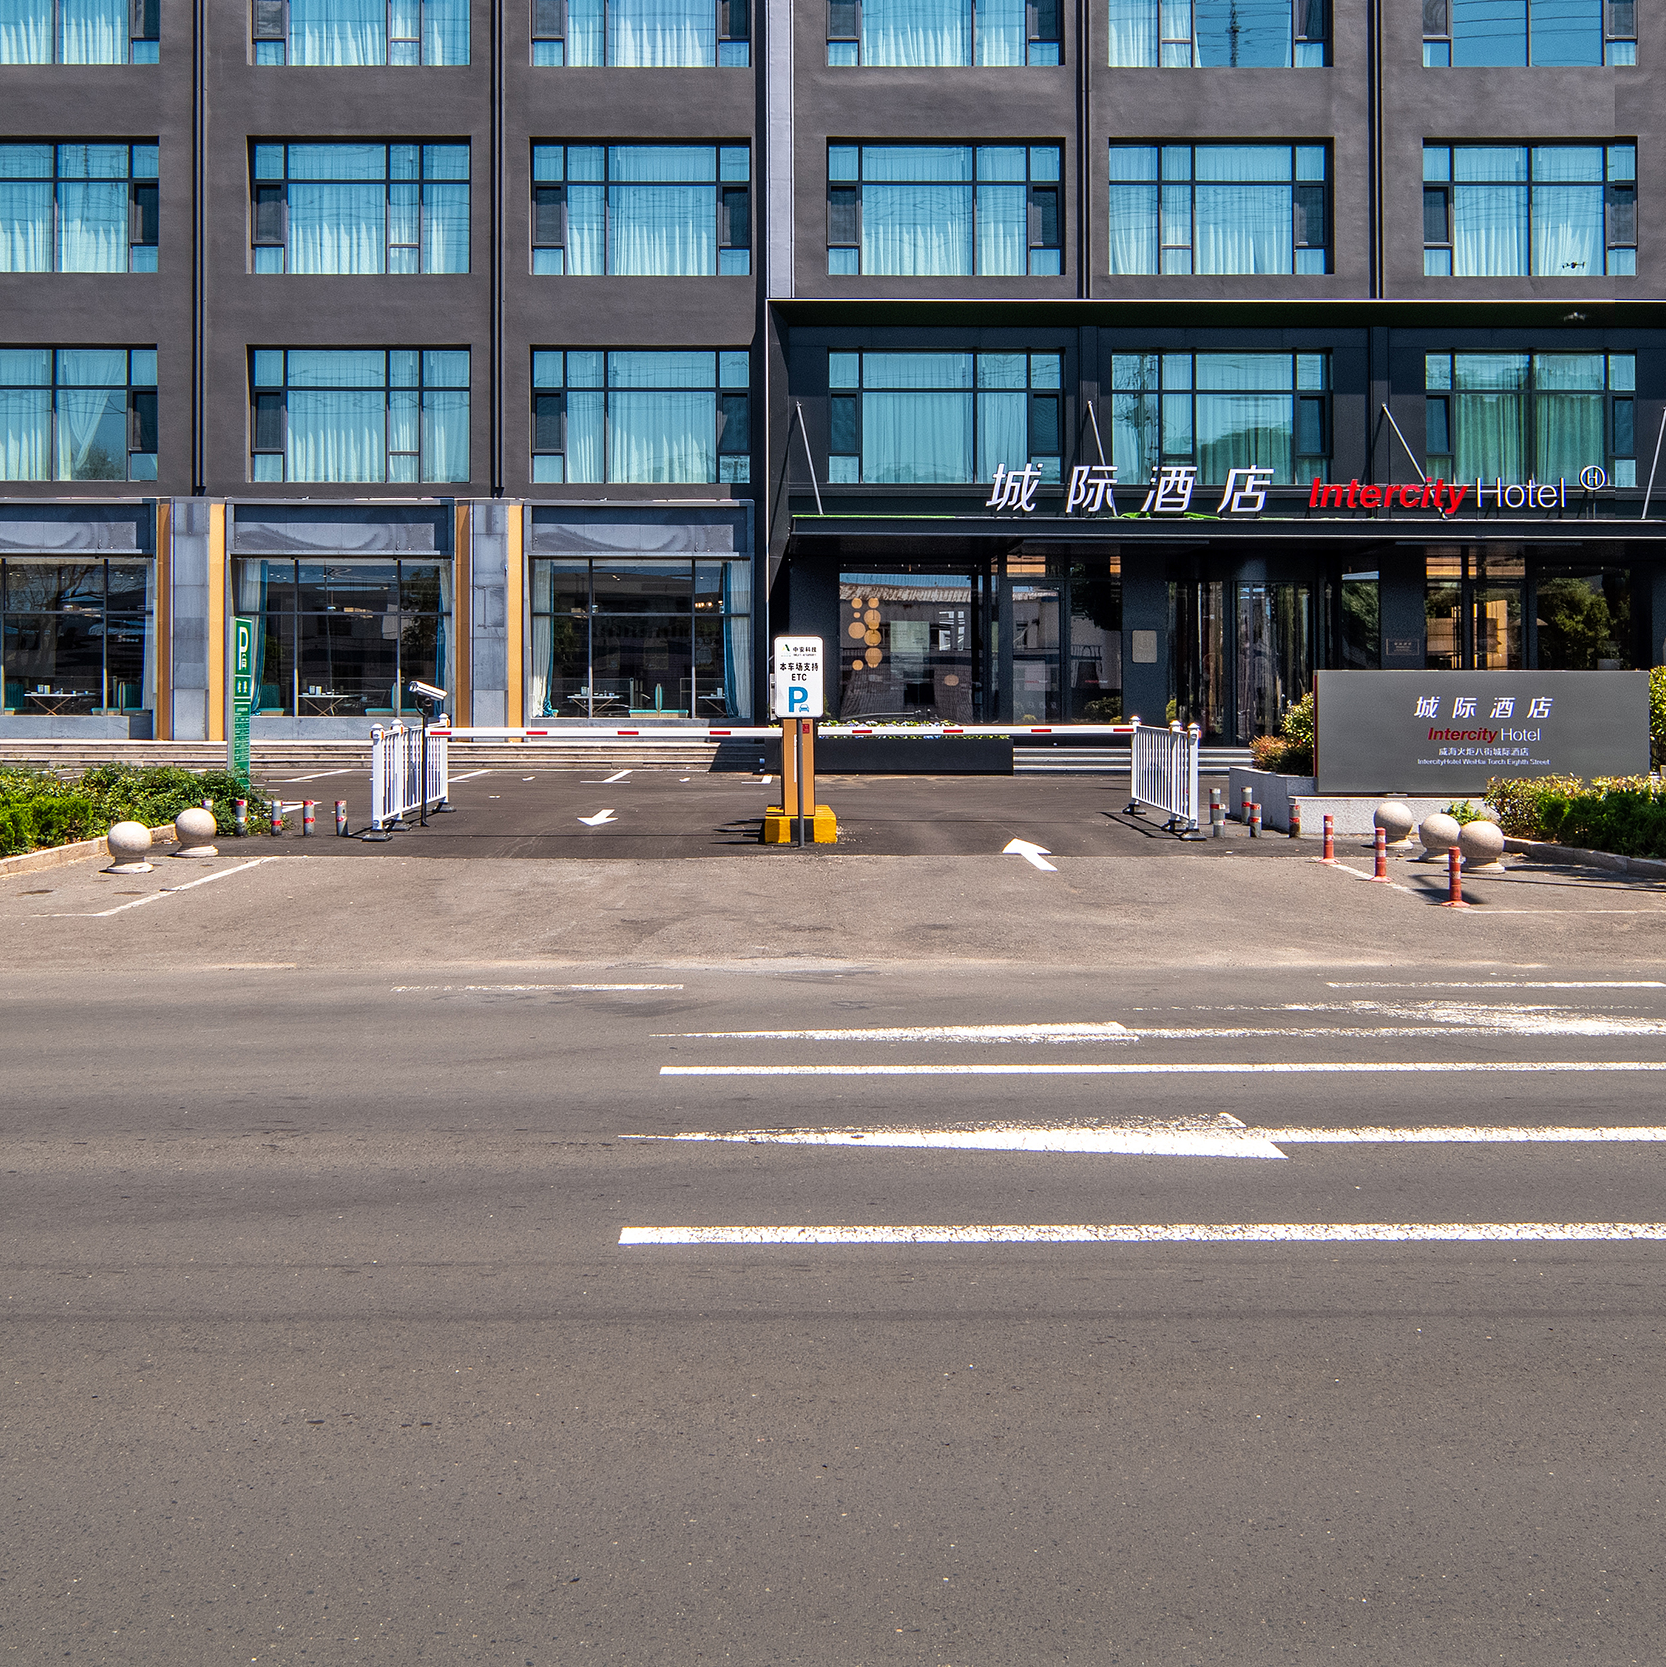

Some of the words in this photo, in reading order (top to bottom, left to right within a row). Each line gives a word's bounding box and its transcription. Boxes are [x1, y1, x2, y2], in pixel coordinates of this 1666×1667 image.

[985, 463, 1275, 514] 城际酒店
[238, 626, 249, 671] P
[779, 662, 819, 672] 本车场支持
[791, 673, 807, 681] ETC
[788, 686, 808, 713] P
[1413, 696, 1553, 719] 城际酒店
